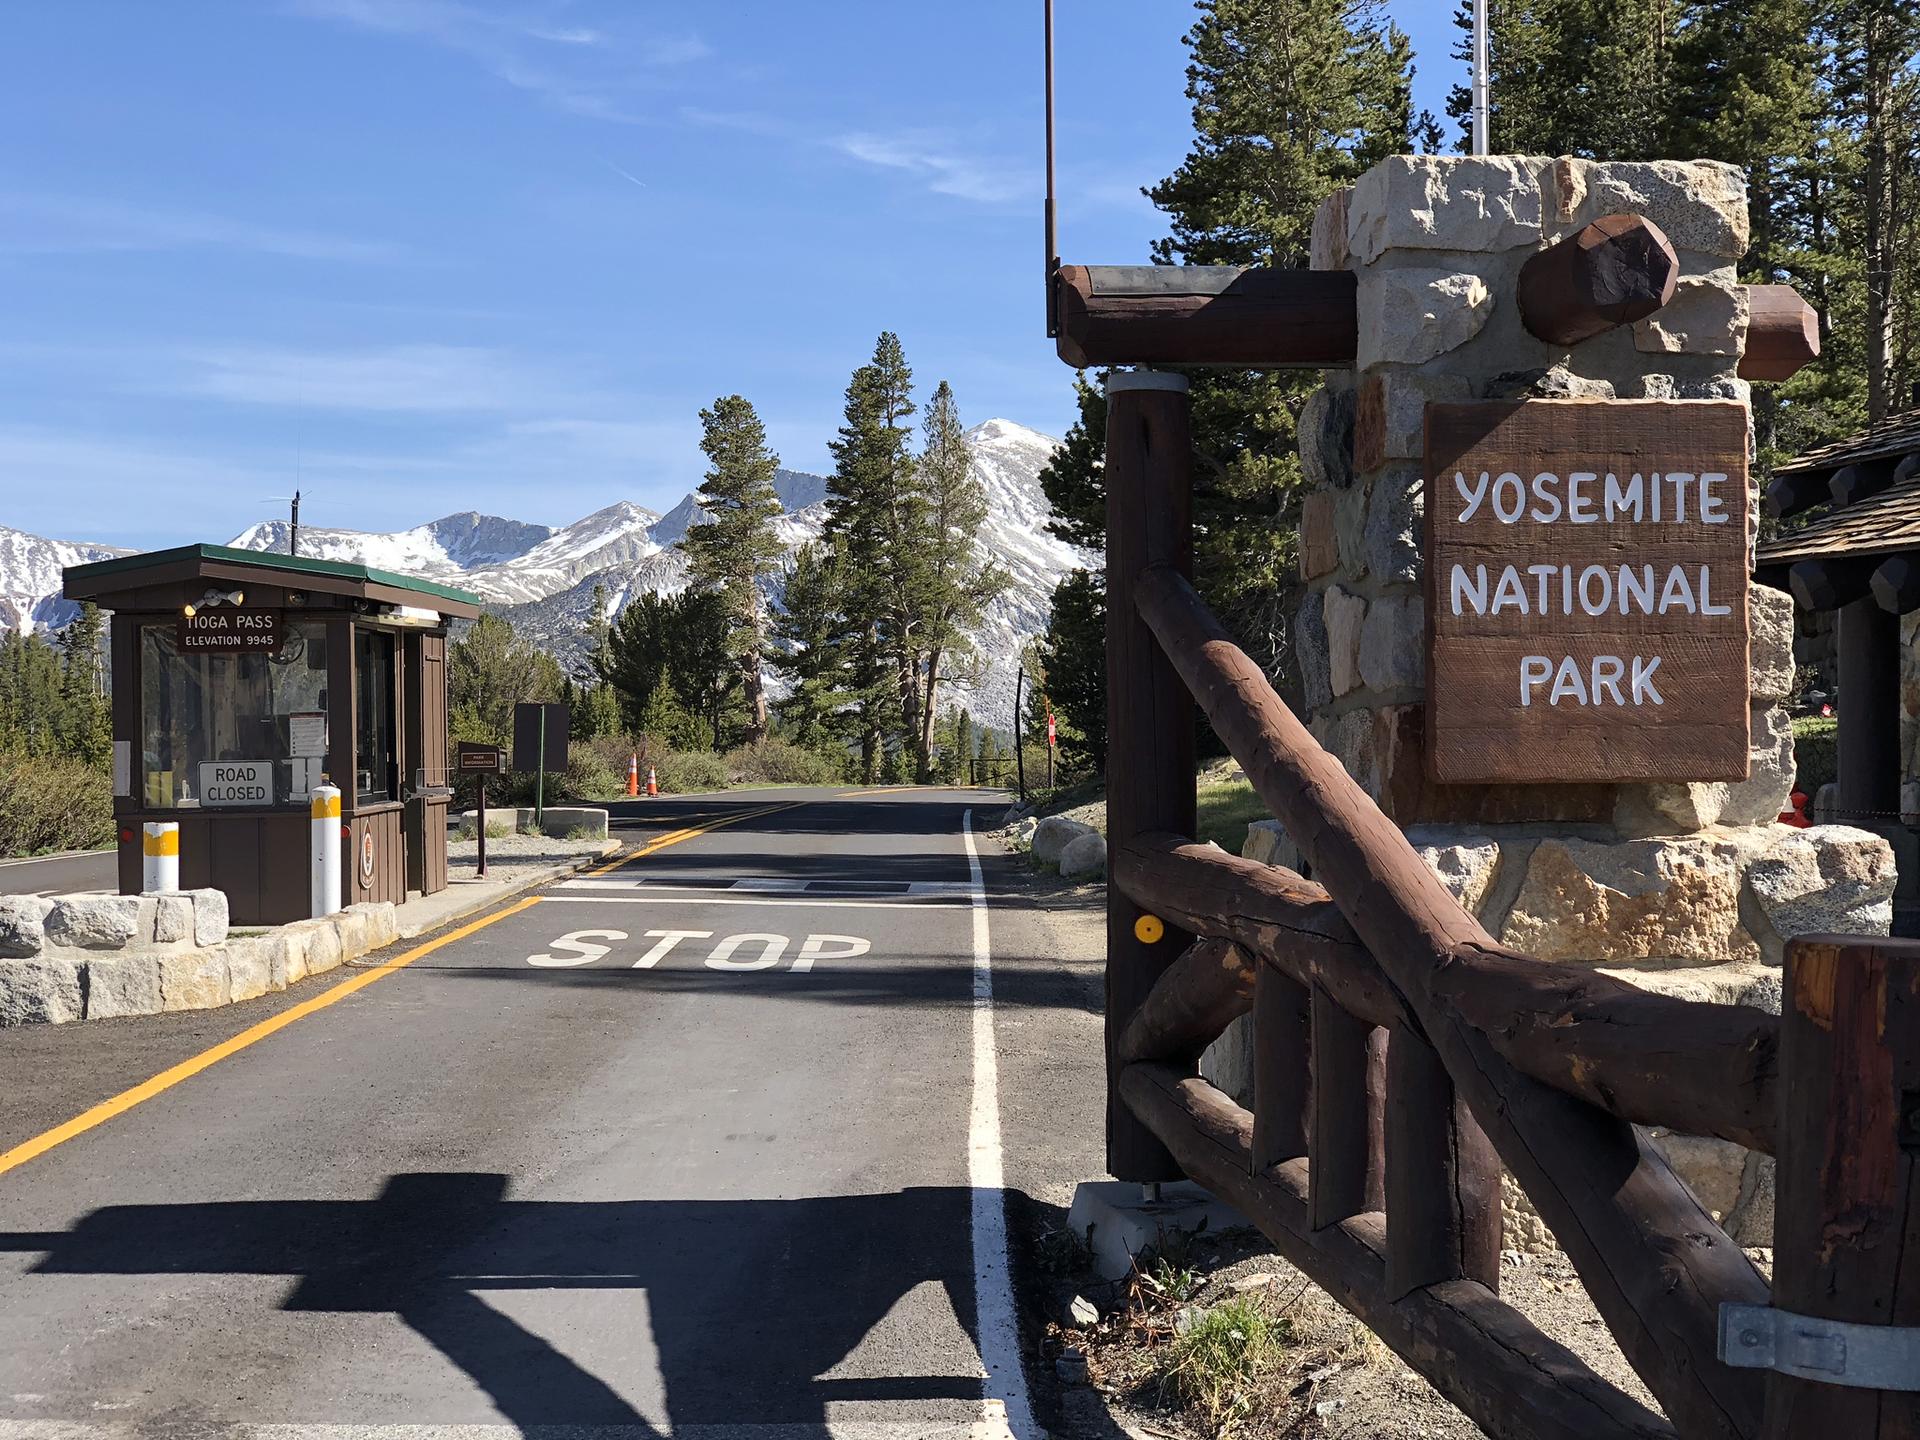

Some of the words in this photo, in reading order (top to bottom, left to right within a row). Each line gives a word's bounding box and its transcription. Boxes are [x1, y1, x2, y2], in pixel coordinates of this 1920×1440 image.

[1454, 471, 1730, 524] YOSEMITE
[1449, 564, 1732, 616] NATIONAL
[185, 615, 228, 629] TIOGA
[236, 615, 273, 629] PASS
[185, 636, 241, 646] ELEVATION
[246, 635, 274, 645] 9945
[1520, 655, 1664, 707] PARK
[215, 767, 257, 782] ROAD
[207, 786, 266, 801] CLOSED
[526, 929, 872, 973] STOP
